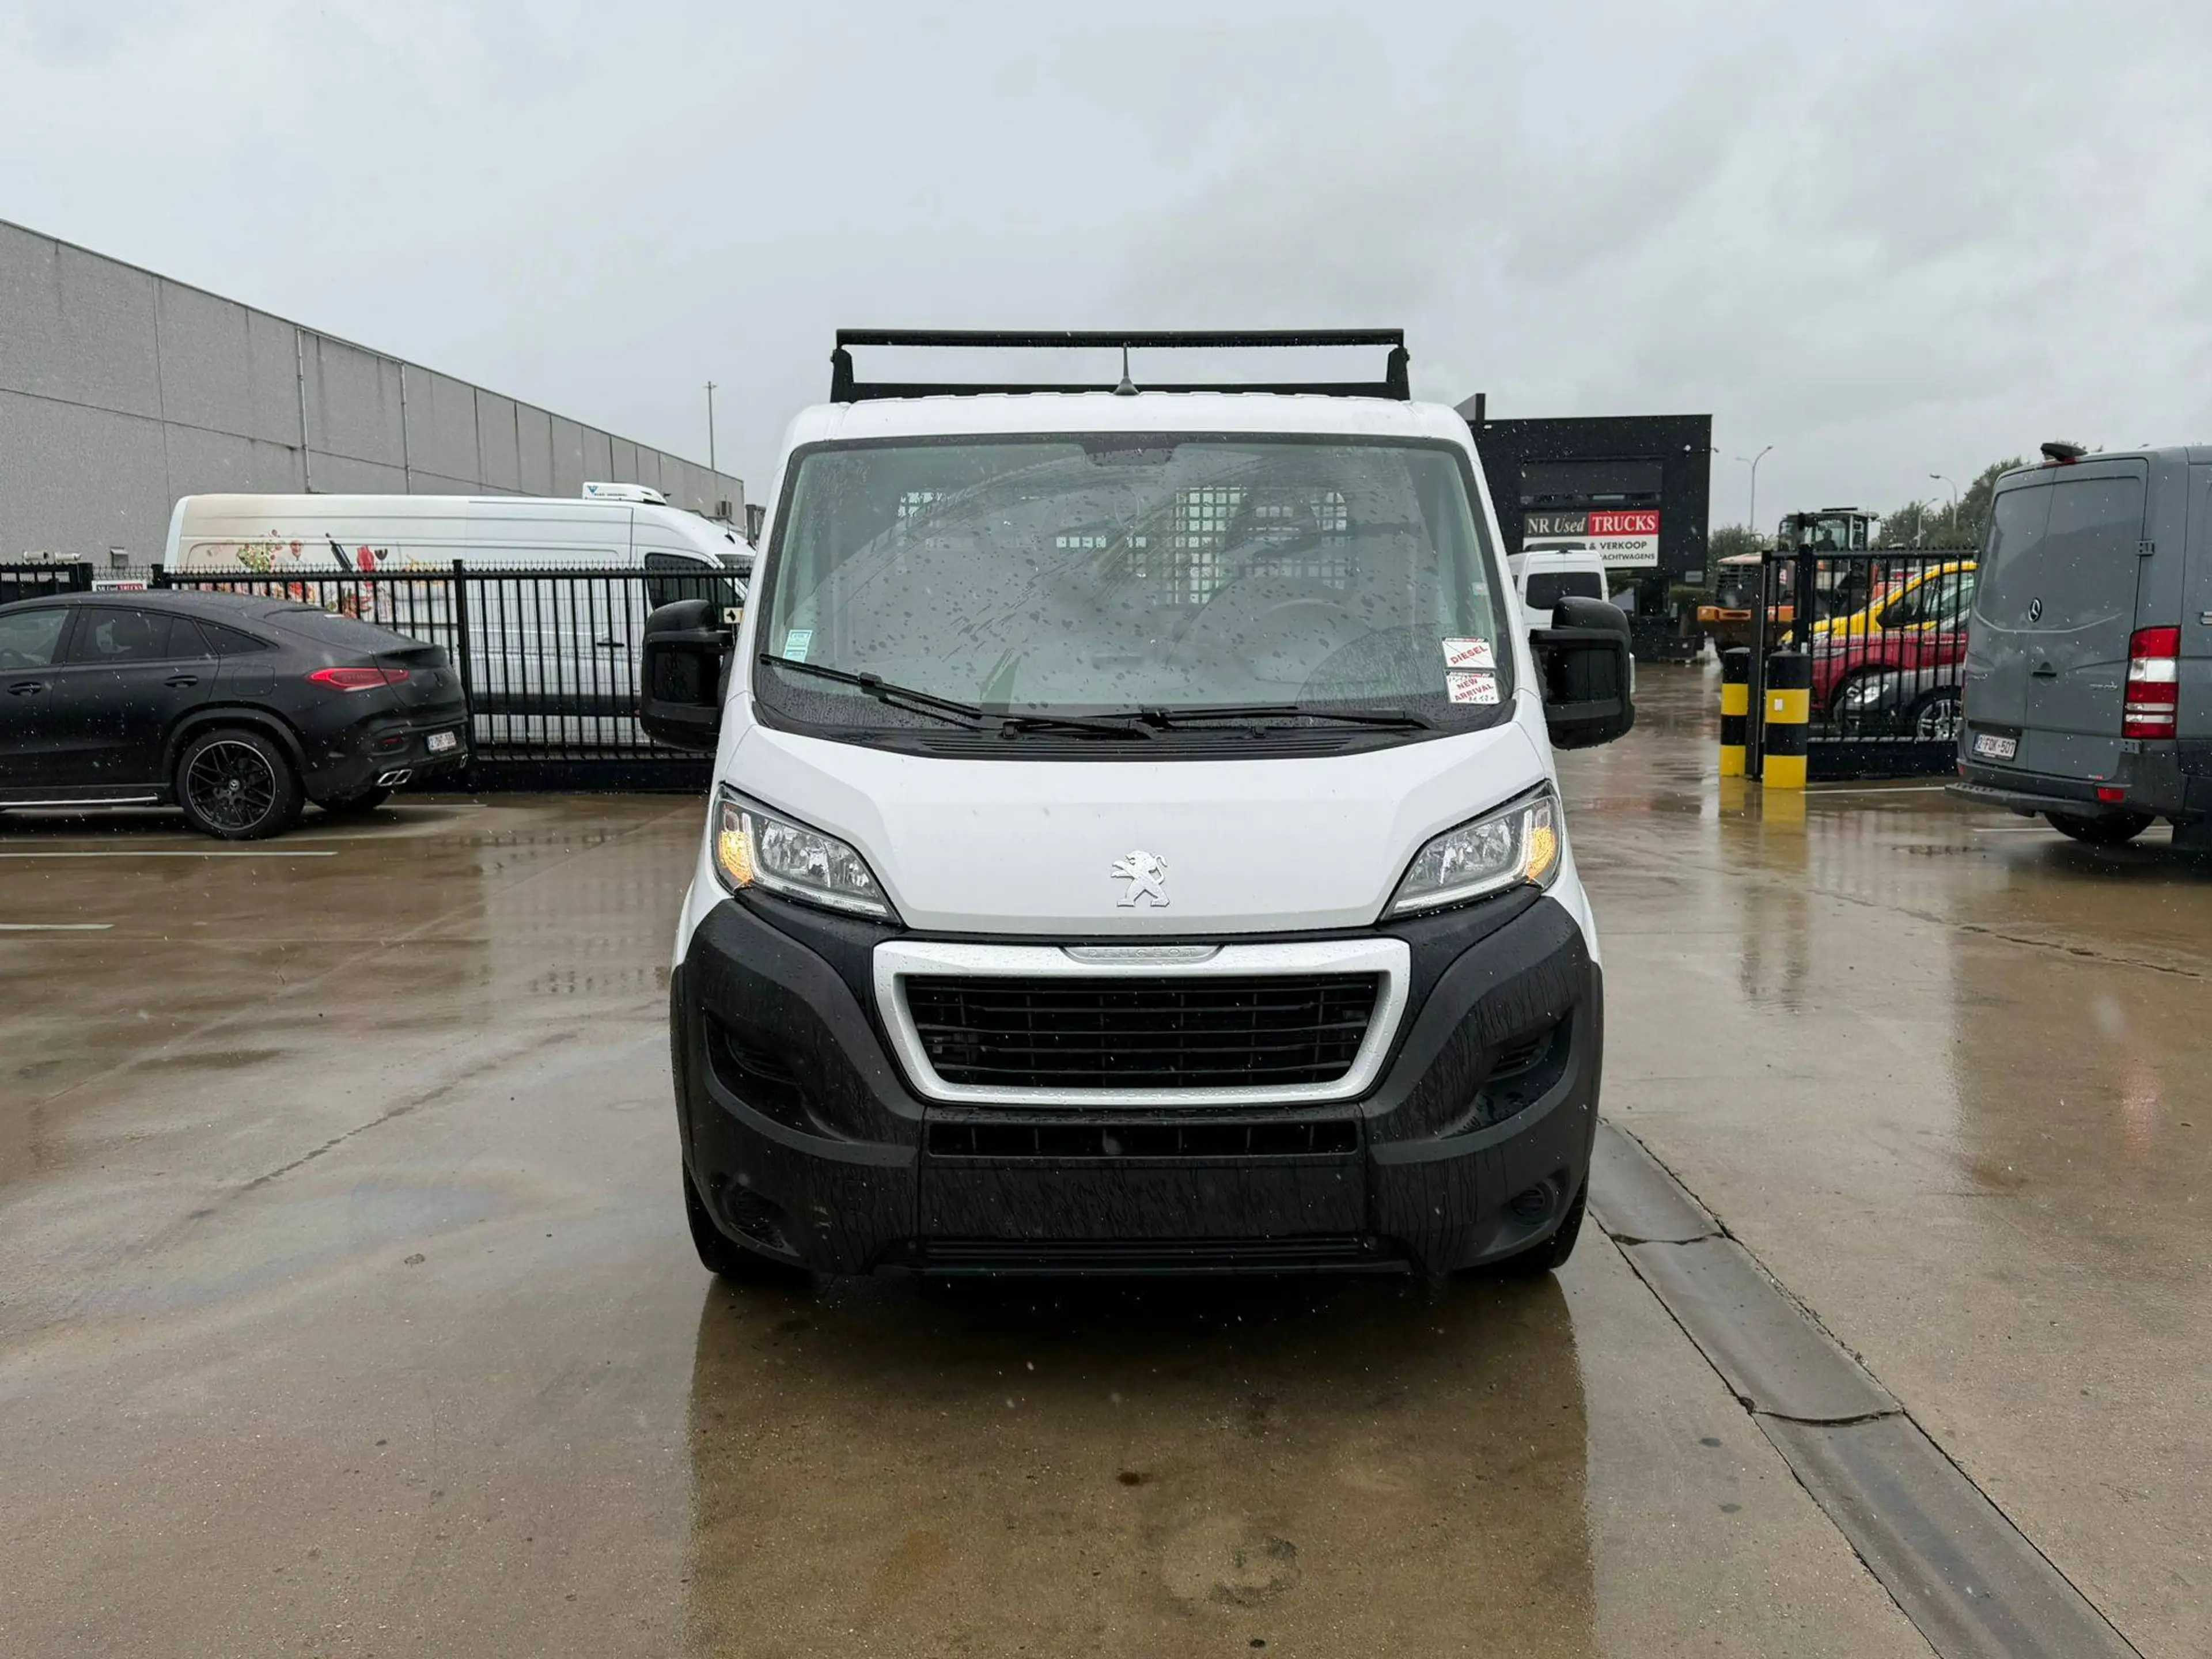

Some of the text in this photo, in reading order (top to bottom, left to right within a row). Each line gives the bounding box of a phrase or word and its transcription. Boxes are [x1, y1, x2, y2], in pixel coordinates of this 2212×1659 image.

[1528, 515, 1656, 534] NR Used TRUCKS
[1600, 541, 1647, 550] VERKOOP
[1450, 645, 1488, 664] DIESEL
[1456, 677, 1478, 690] NEW
[1455, 683, 1494, 701] ARRIVAL
[1088, 948, 1197, 957] PEUGEOT
